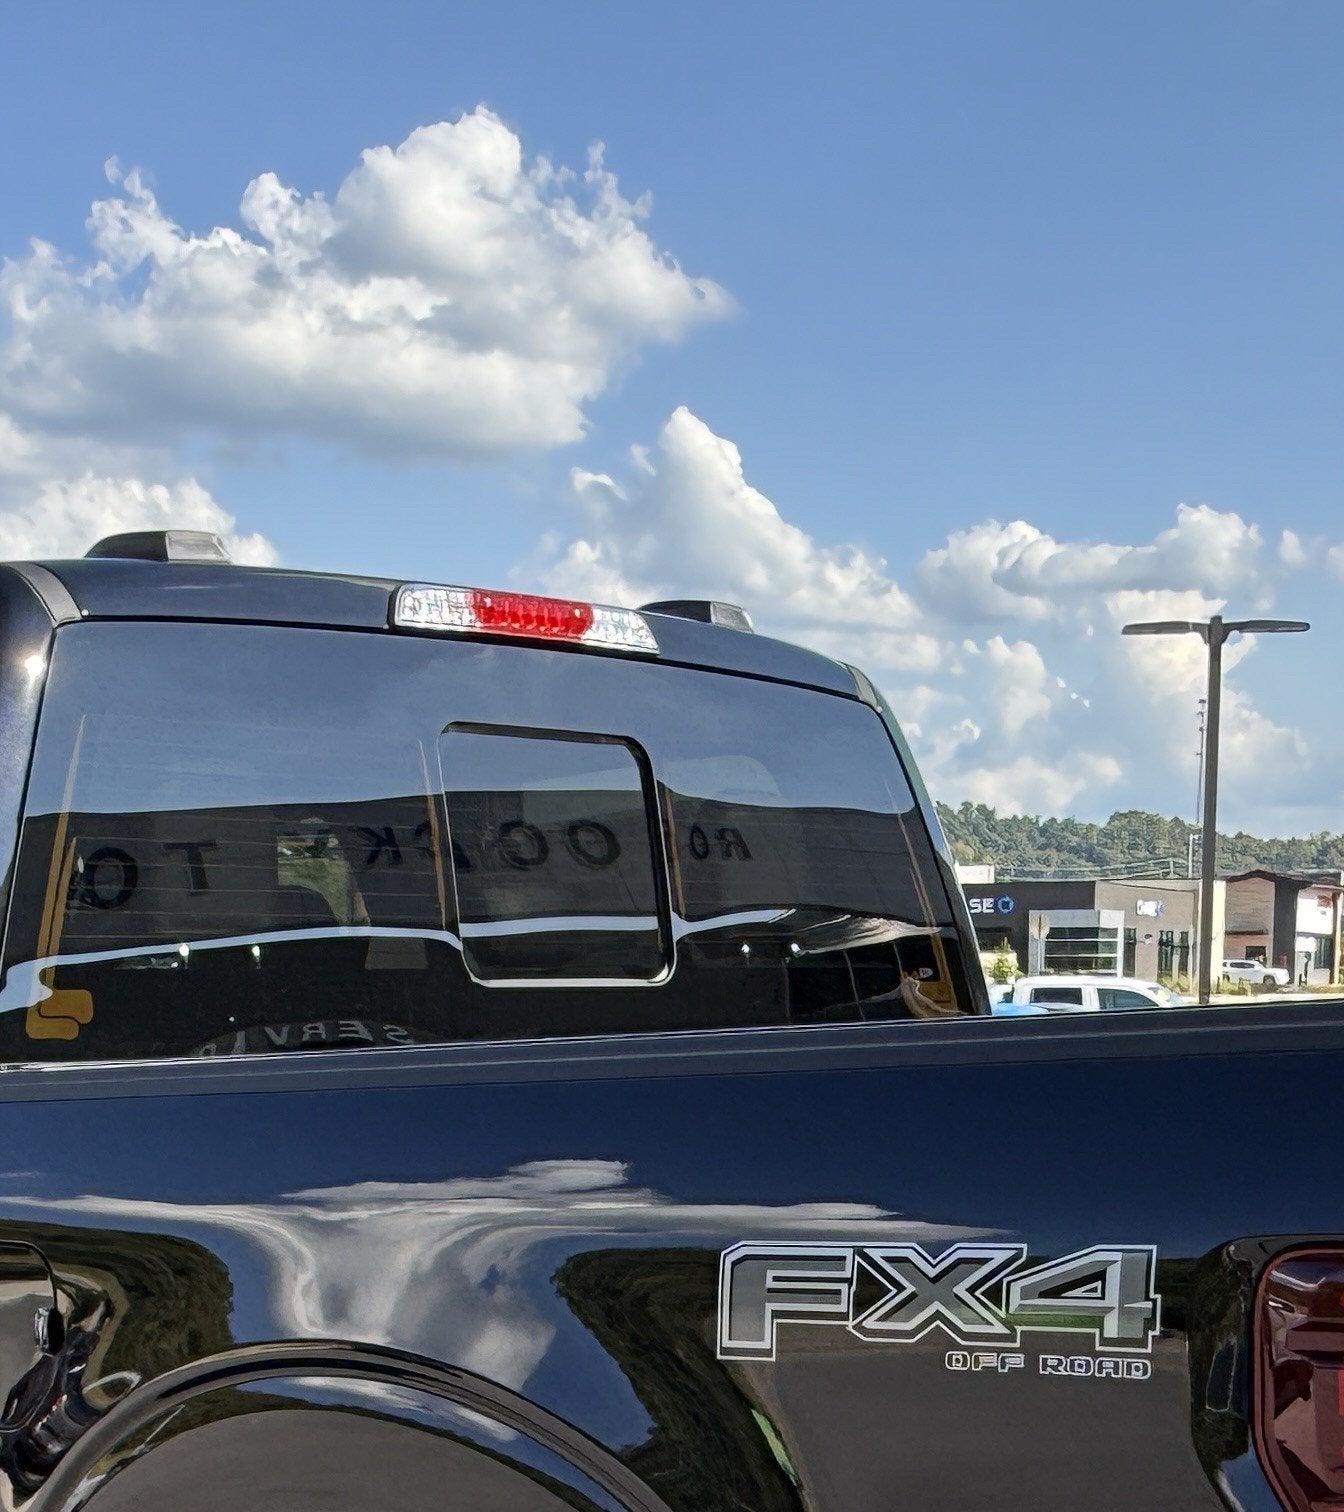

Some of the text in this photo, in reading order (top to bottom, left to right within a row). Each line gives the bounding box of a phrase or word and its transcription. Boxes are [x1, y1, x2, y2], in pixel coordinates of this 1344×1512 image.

[717, 1240, 1161, 1362] FX4
[945, 1350, 1152, 1380] OFF ROAD
